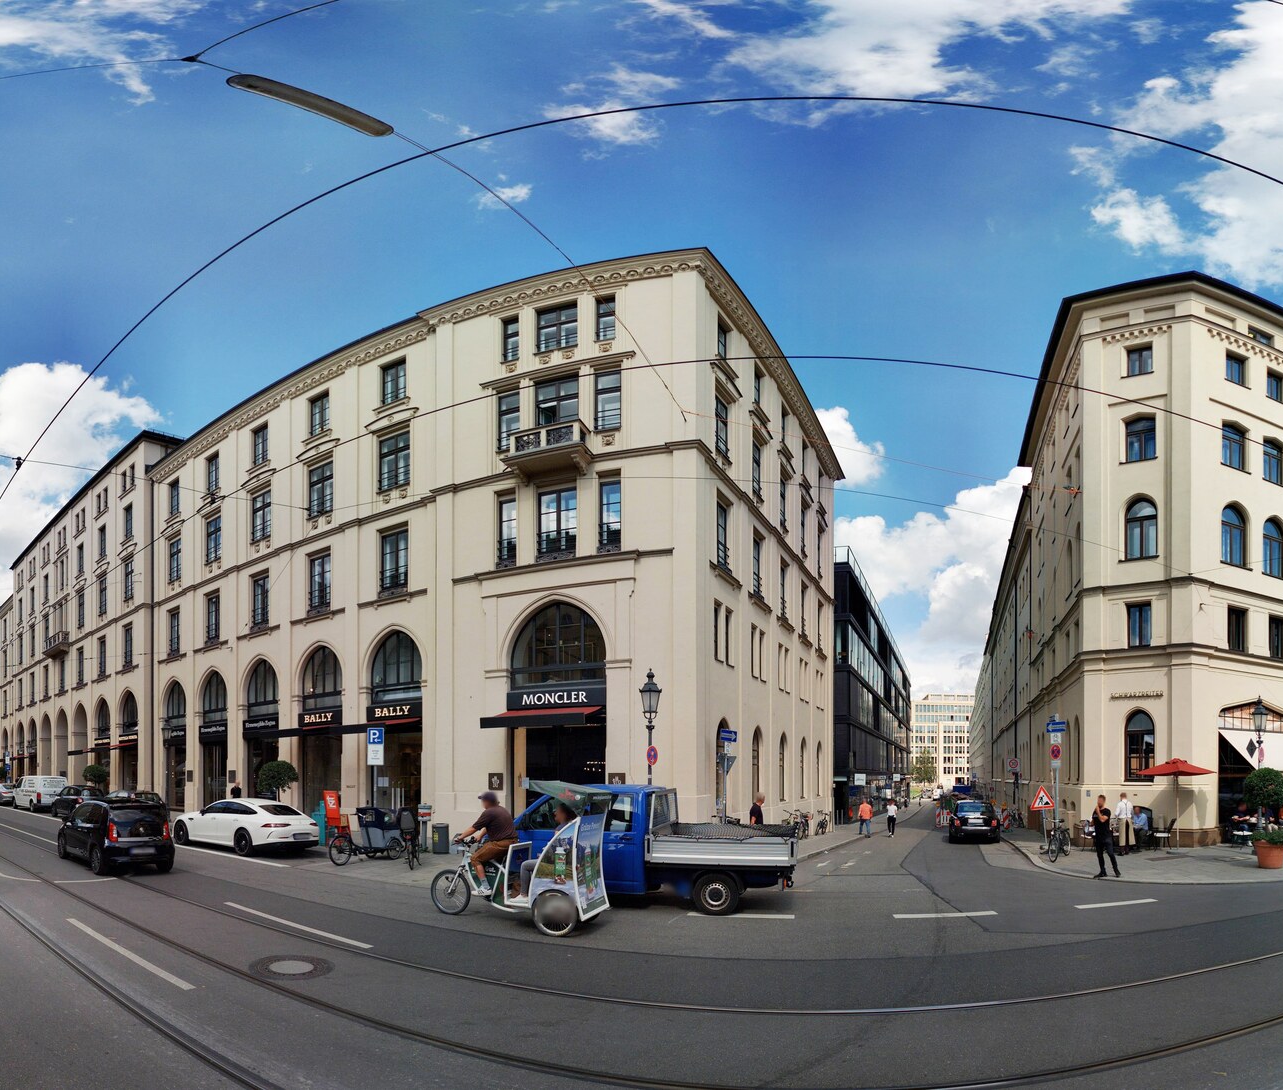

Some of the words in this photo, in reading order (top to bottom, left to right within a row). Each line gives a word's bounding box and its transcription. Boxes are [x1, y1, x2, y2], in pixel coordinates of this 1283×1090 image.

[521, 691, 588, 705] MONCLER
[304, 712, 333, 723] BALLY
[374, 705, 411, 718] BALLY
[369, 730, 379, 743] P
